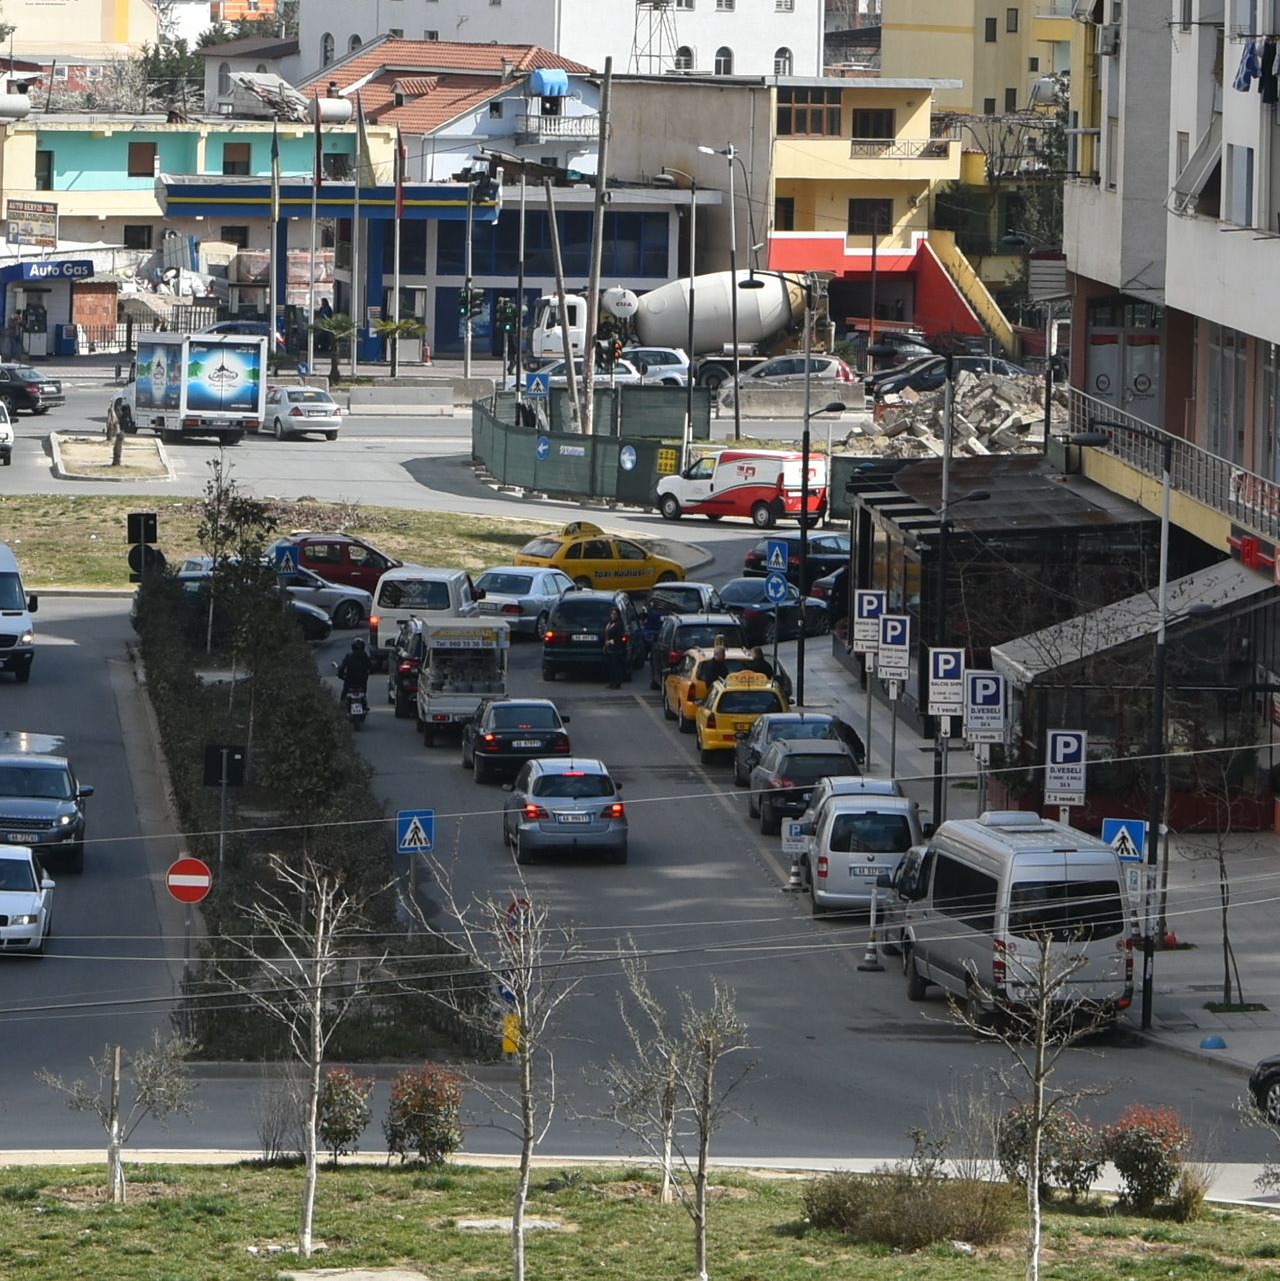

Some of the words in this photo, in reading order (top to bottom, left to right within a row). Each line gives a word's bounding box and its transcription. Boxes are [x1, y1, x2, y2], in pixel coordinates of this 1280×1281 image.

[29, 264, 60, 277] Auto
[62, 263, 88, 276] Gas
[862, 595, 878, 617] P
[887, 620, 902, 643] P
[938, 653, 956, 677] P
[976, 679, 997, 704] P
[1056, 735, 1079, 763] P
[1050, 766, 1082, 774] D.VESELI
